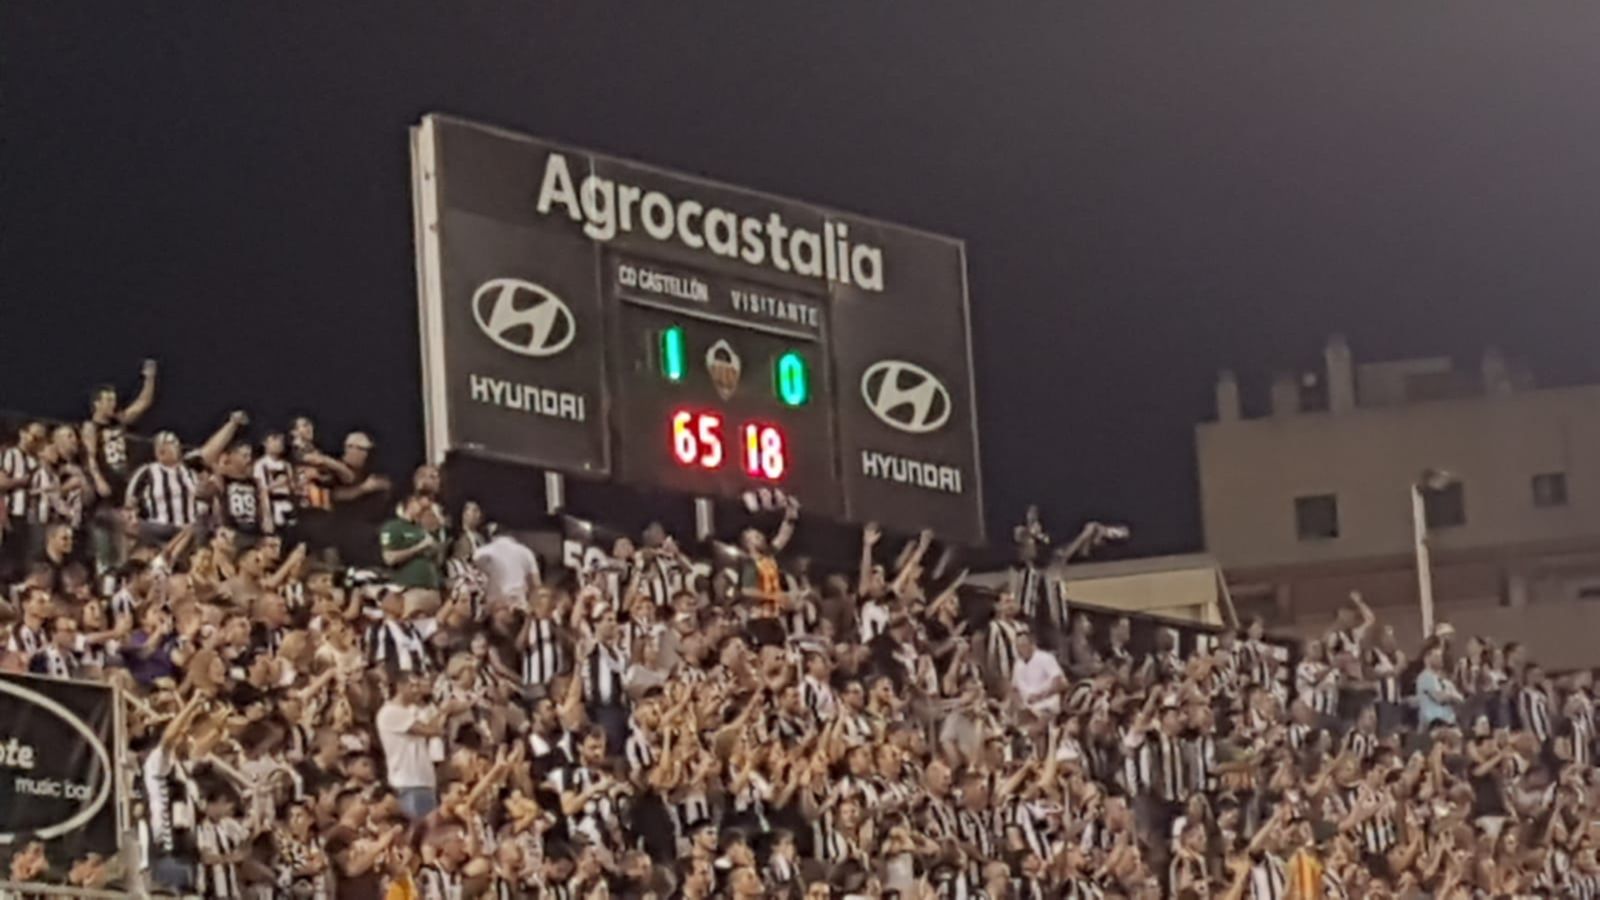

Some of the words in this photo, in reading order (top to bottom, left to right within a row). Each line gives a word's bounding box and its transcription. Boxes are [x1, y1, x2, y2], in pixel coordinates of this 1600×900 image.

[536, 153, 884, 292] Agrocastalia
[731, 290, 818, 327] VISITANTE
[665, 327, 682, 380] 1
[779, 353, 807, 406] 0
[470, 374, 585, 421] HYUNDAI
[673, 410, 723, 468] 65
[746, 423, 784, 479] 18
[862, 450, 962, 494] HYUNDAI
